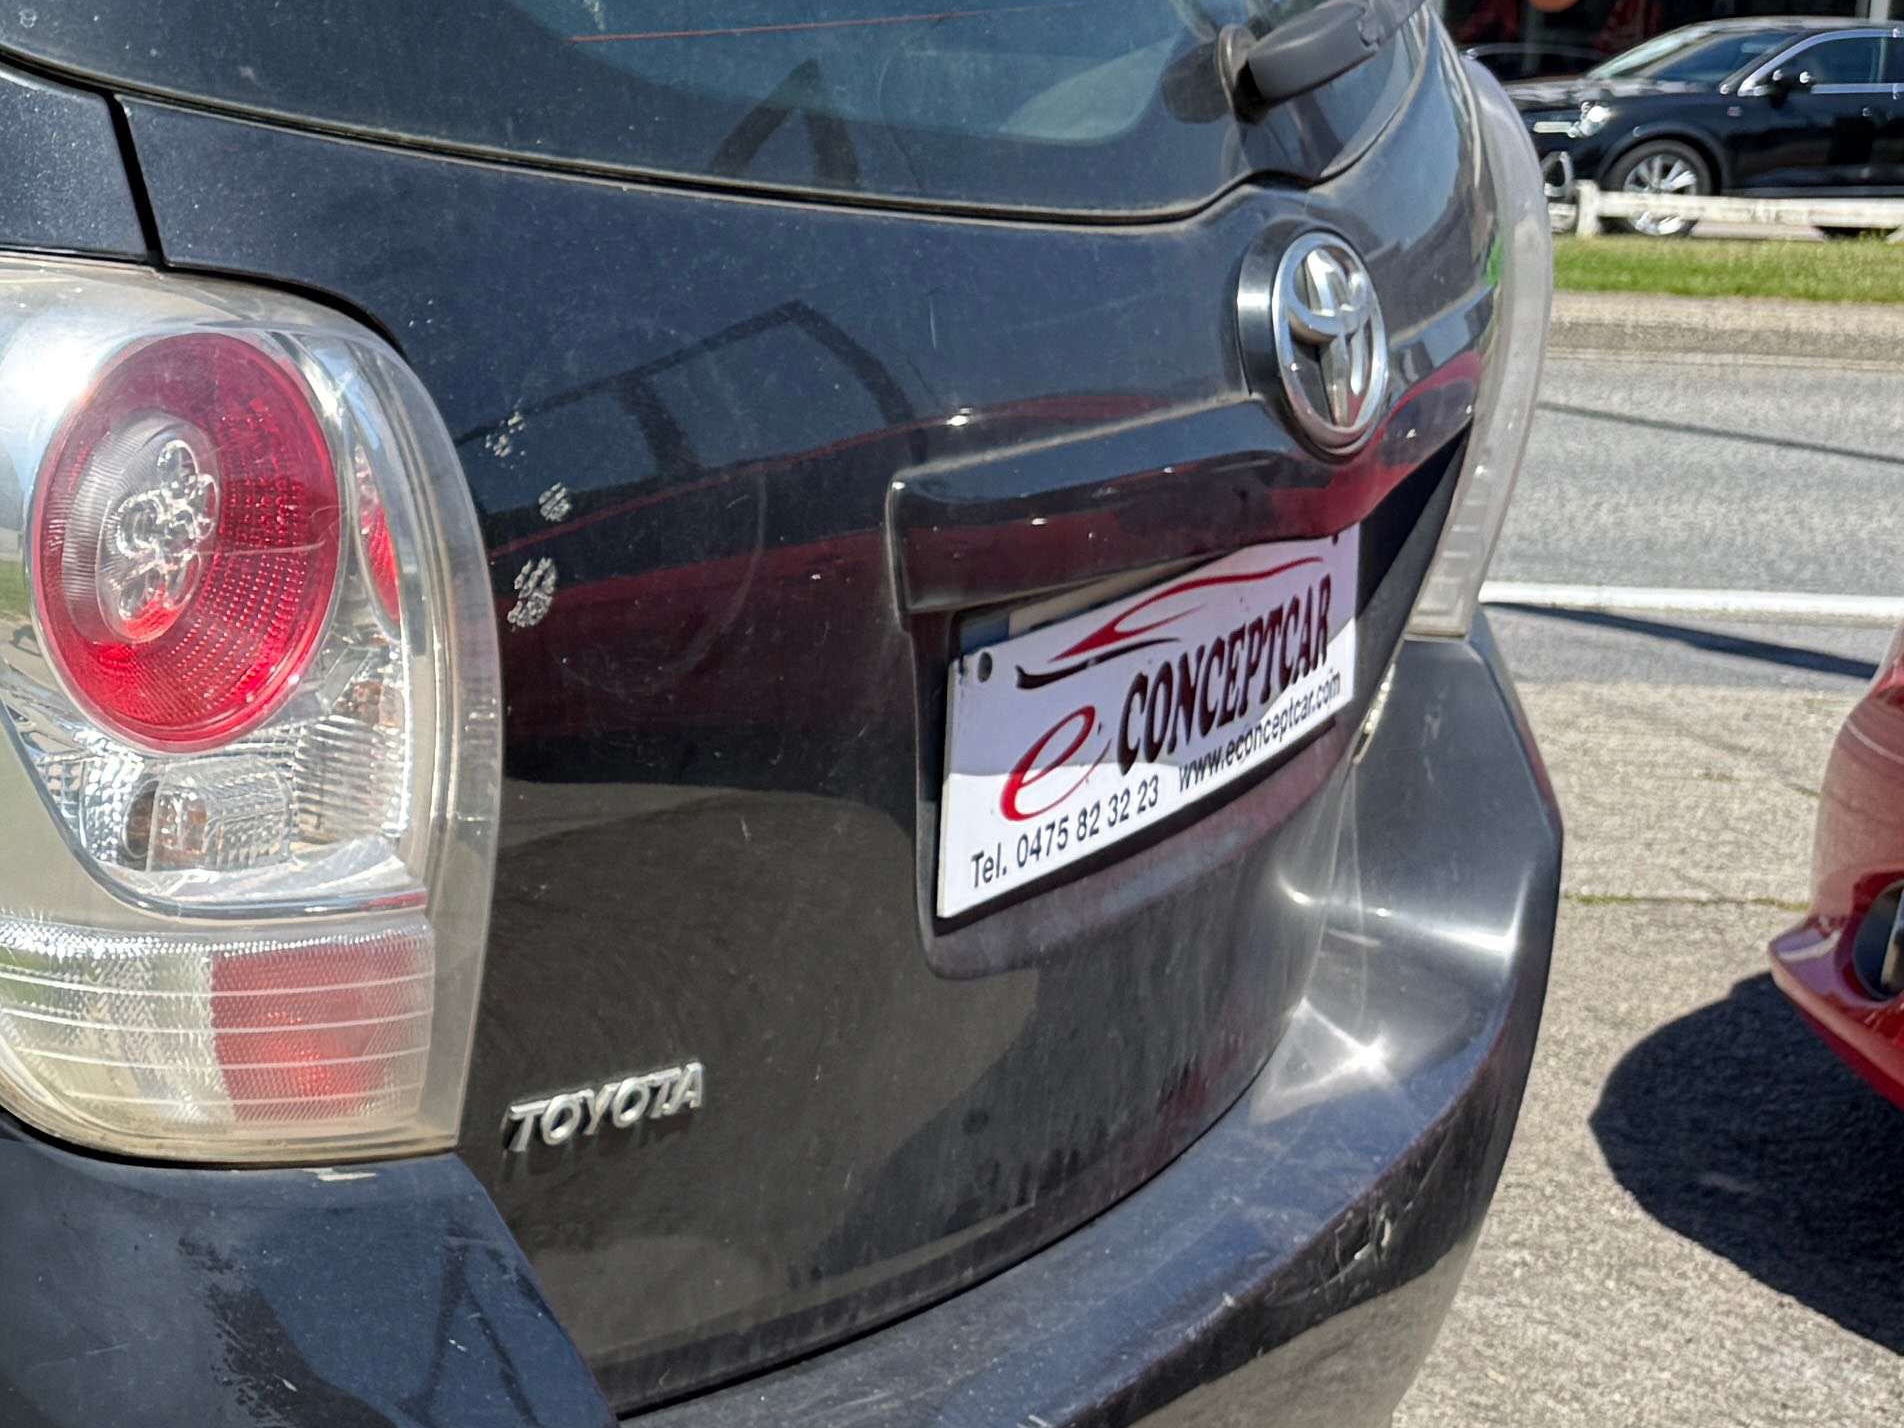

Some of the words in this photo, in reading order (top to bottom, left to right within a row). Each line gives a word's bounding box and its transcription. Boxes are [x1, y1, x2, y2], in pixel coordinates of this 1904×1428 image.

[1117, 573, 1331, 775] CONCEPTCAR
[971, 842, 1007, 888] Tel.
[1016, 815, 1069, 868] 0475
[1076, 801, 1100, 842] 82
[1107, 789, 1130, 828] 32
[1136, 775, 1159, 815] 23
[1179, 671, 1341, 792] www.econceptcar.com
[509, 1062, 704, 1152] TOYOTA
